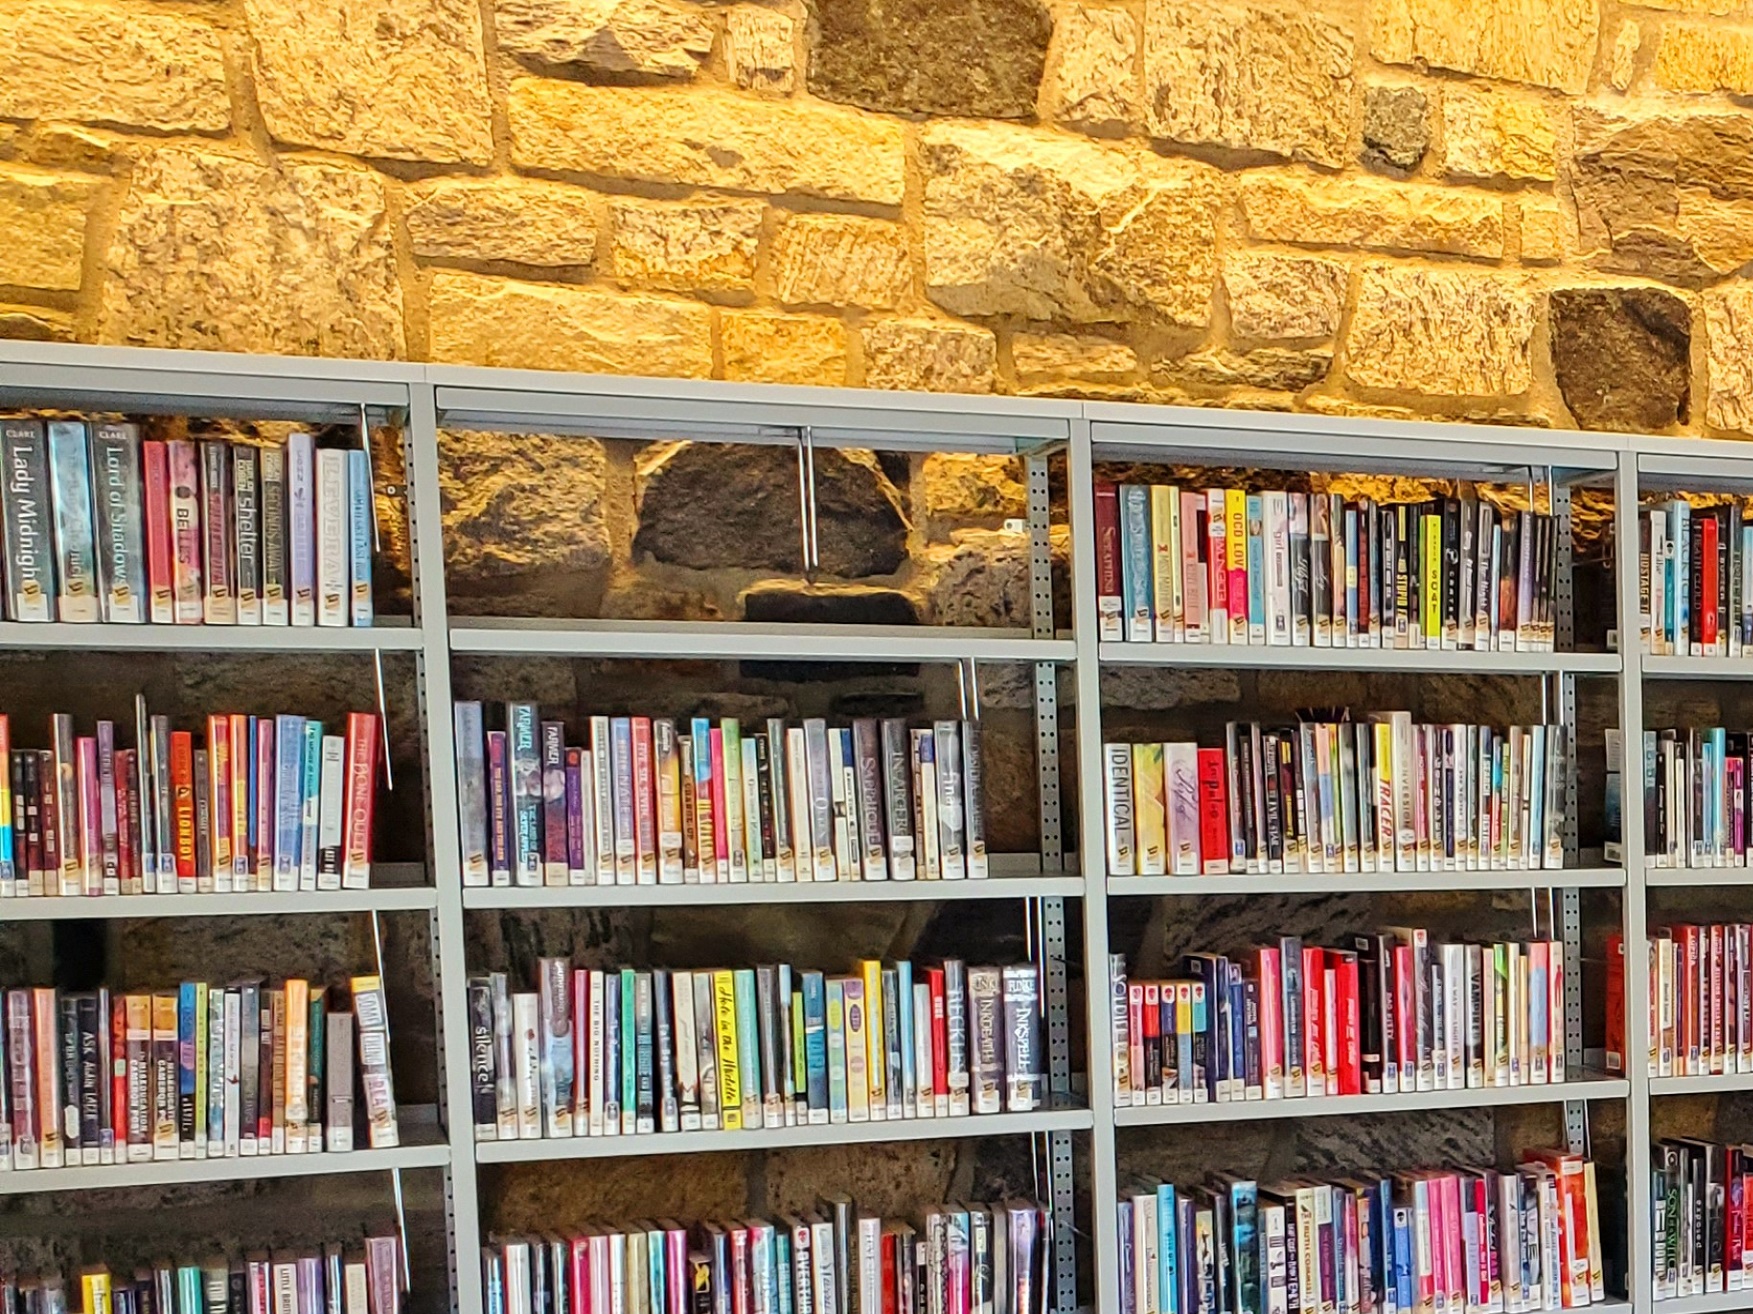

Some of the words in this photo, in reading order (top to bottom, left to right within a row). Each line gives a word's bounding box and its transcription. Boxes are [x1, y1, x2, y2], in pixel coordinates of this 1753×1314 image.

[10, 446, 35, 493] Lady
[106, 446, 126, 486] Lord
[110, 491, 127, 508] of
[1233, 512, 1244, 539] OCD
[15, 499, 41, 580] Midnigh
[112, 512, 129, 584] Shadows
[177, 508, 192, 563] BELLES
[239, 497, 257, 565] shelter
[1233, 542, 1244, 568] LOV
[1111, 748, 1130, 836] IDENTICAL
[1379, 778, 1393, 837] TRACER
[178, 806, 193, 861] LIONBOY
[352, 809, 368, 852] QUEE
[475, 1026, 490, 1083] silence
